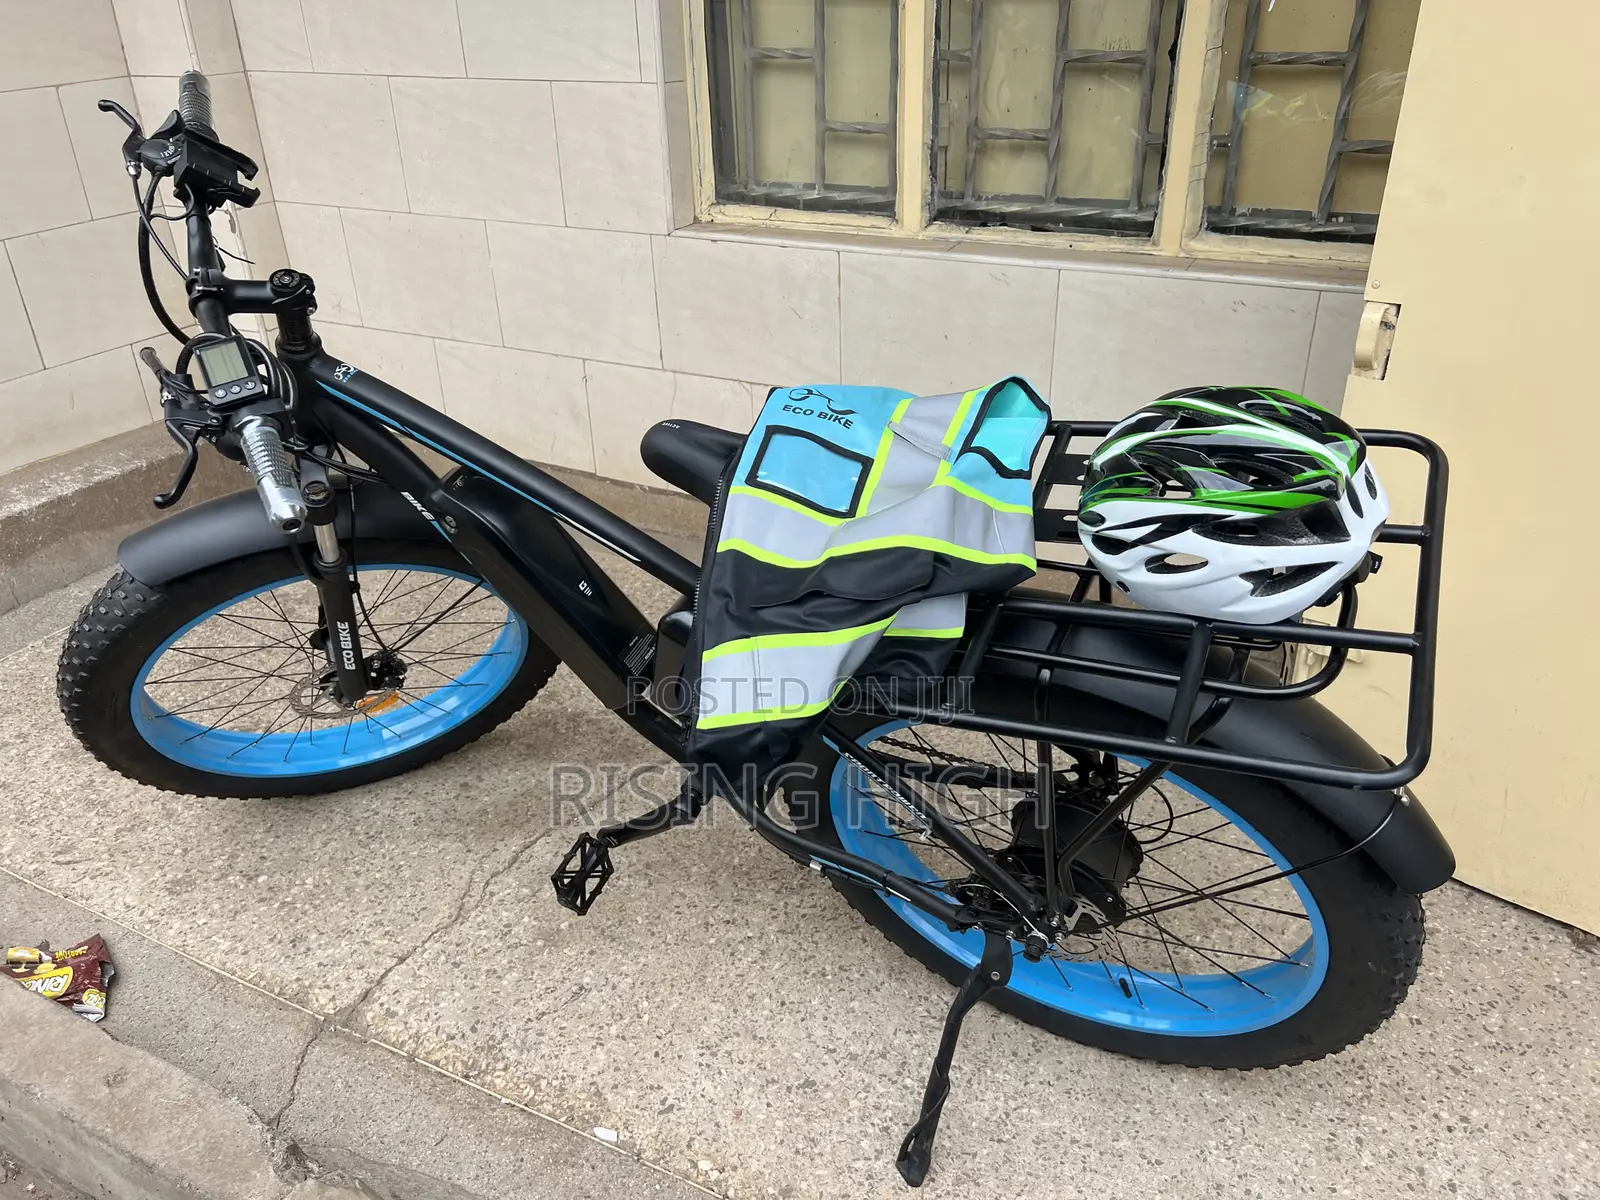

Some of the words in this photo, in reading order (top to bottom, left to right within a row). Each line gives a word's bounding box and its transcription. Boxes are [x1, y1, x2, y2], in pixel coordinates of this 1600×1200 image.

[782, 404, 815, 416] ECO
[816, 411, 854, 430] BIKE
[400, 491, 436, 521] BIKE
[336, 620, 353, 649] BIKE
[342, 650, 356, 670] ECO
